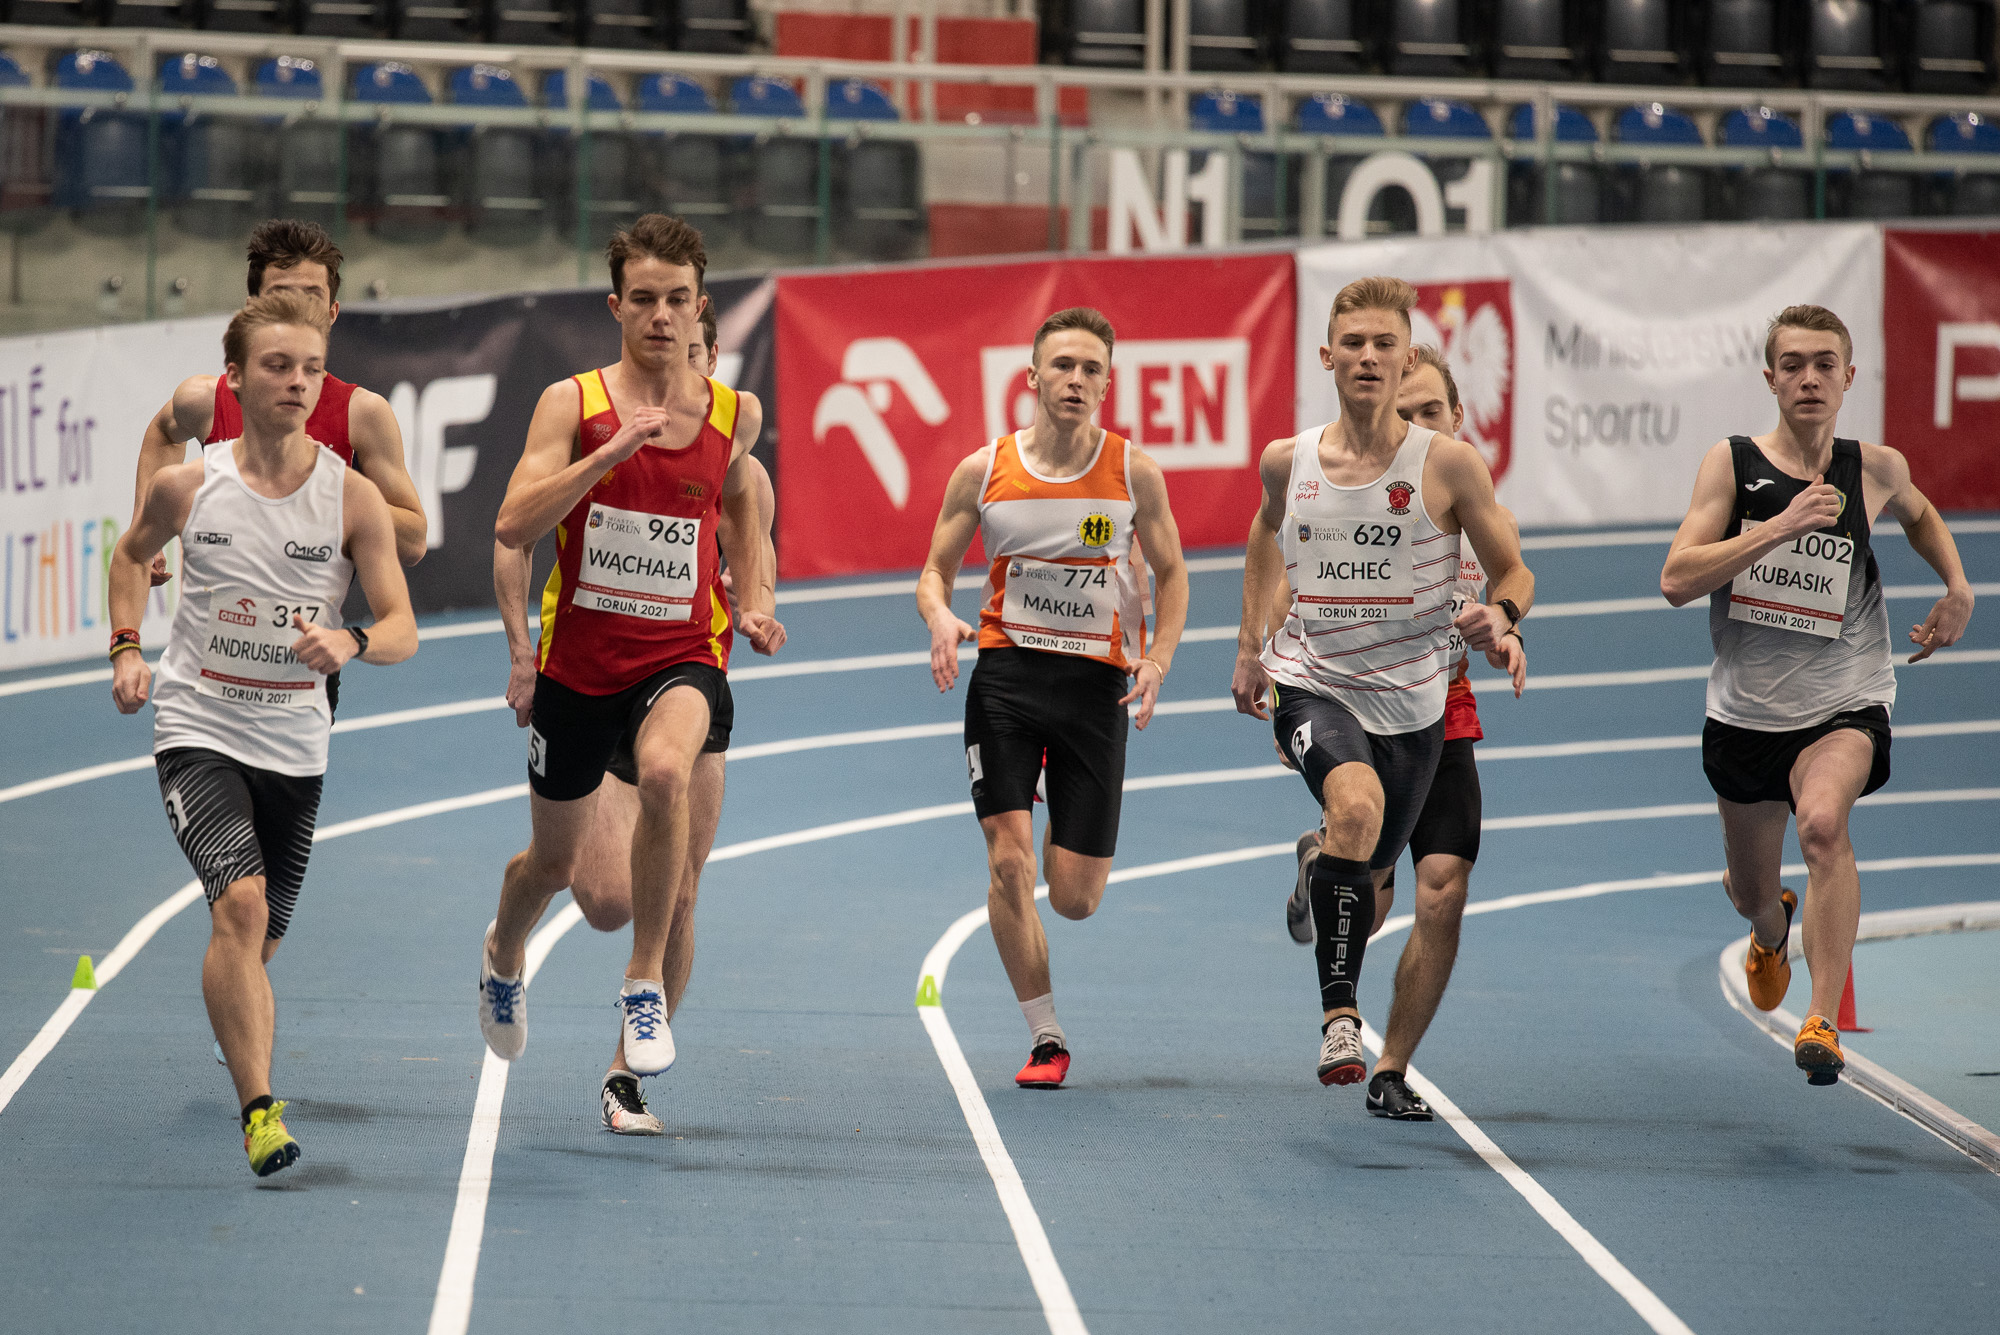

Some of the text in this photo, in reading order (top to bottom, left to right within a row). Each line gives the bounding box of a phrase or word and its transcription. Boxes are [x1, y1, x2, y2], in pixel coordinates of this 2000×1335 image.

[1106, 148, 1229, 256] N1
[1004, 363, 1229, 447] OLEN
[1545, 394, 1682, 456] Sportu
[58, 397, 96, 488] for
[605, 520, 642, 535] TORUŃ
[608, 516, 635, 525] MIASTO
[648, 519, 696, 546] 963
[1313, 531, 1348, 541] TORUŃ
[1353, 524, 1402, 546] 629
[1790, 535, 1852, 565] 1002
[588, 547, 692, 581] WĄCHAŁA
[1316, 558, 1392, 580] JACHEĆ
[1025, 571, 1058, 582] TORUŃ
[1063, 568, 1107, 589] 774
[1459, 571, 1484, 581] luszki
[1749, 563, 1834, 595] KUBASIK
[596, 597, 668, 617] TORUŃ 2021
[1023, 593, 1096, 618] MAKIŁA
[1318, 605, 1388, 618] TORUŃ 2021
[220, 611, 254, 626] ORLEN
[1750, 609, 1816, 630] TORUŃ 2021
[208, 634, 300, 665] ANDRUSIEW
[1022, 635, 1087, 651] TORUŃ 2021
[222, 686, 292, 704] TORUŃ 2021
[529, 731, 541, 768] 5
[1294, 730, 1305, 761] 3
[1330, 885, 1359, 976] kalenji
